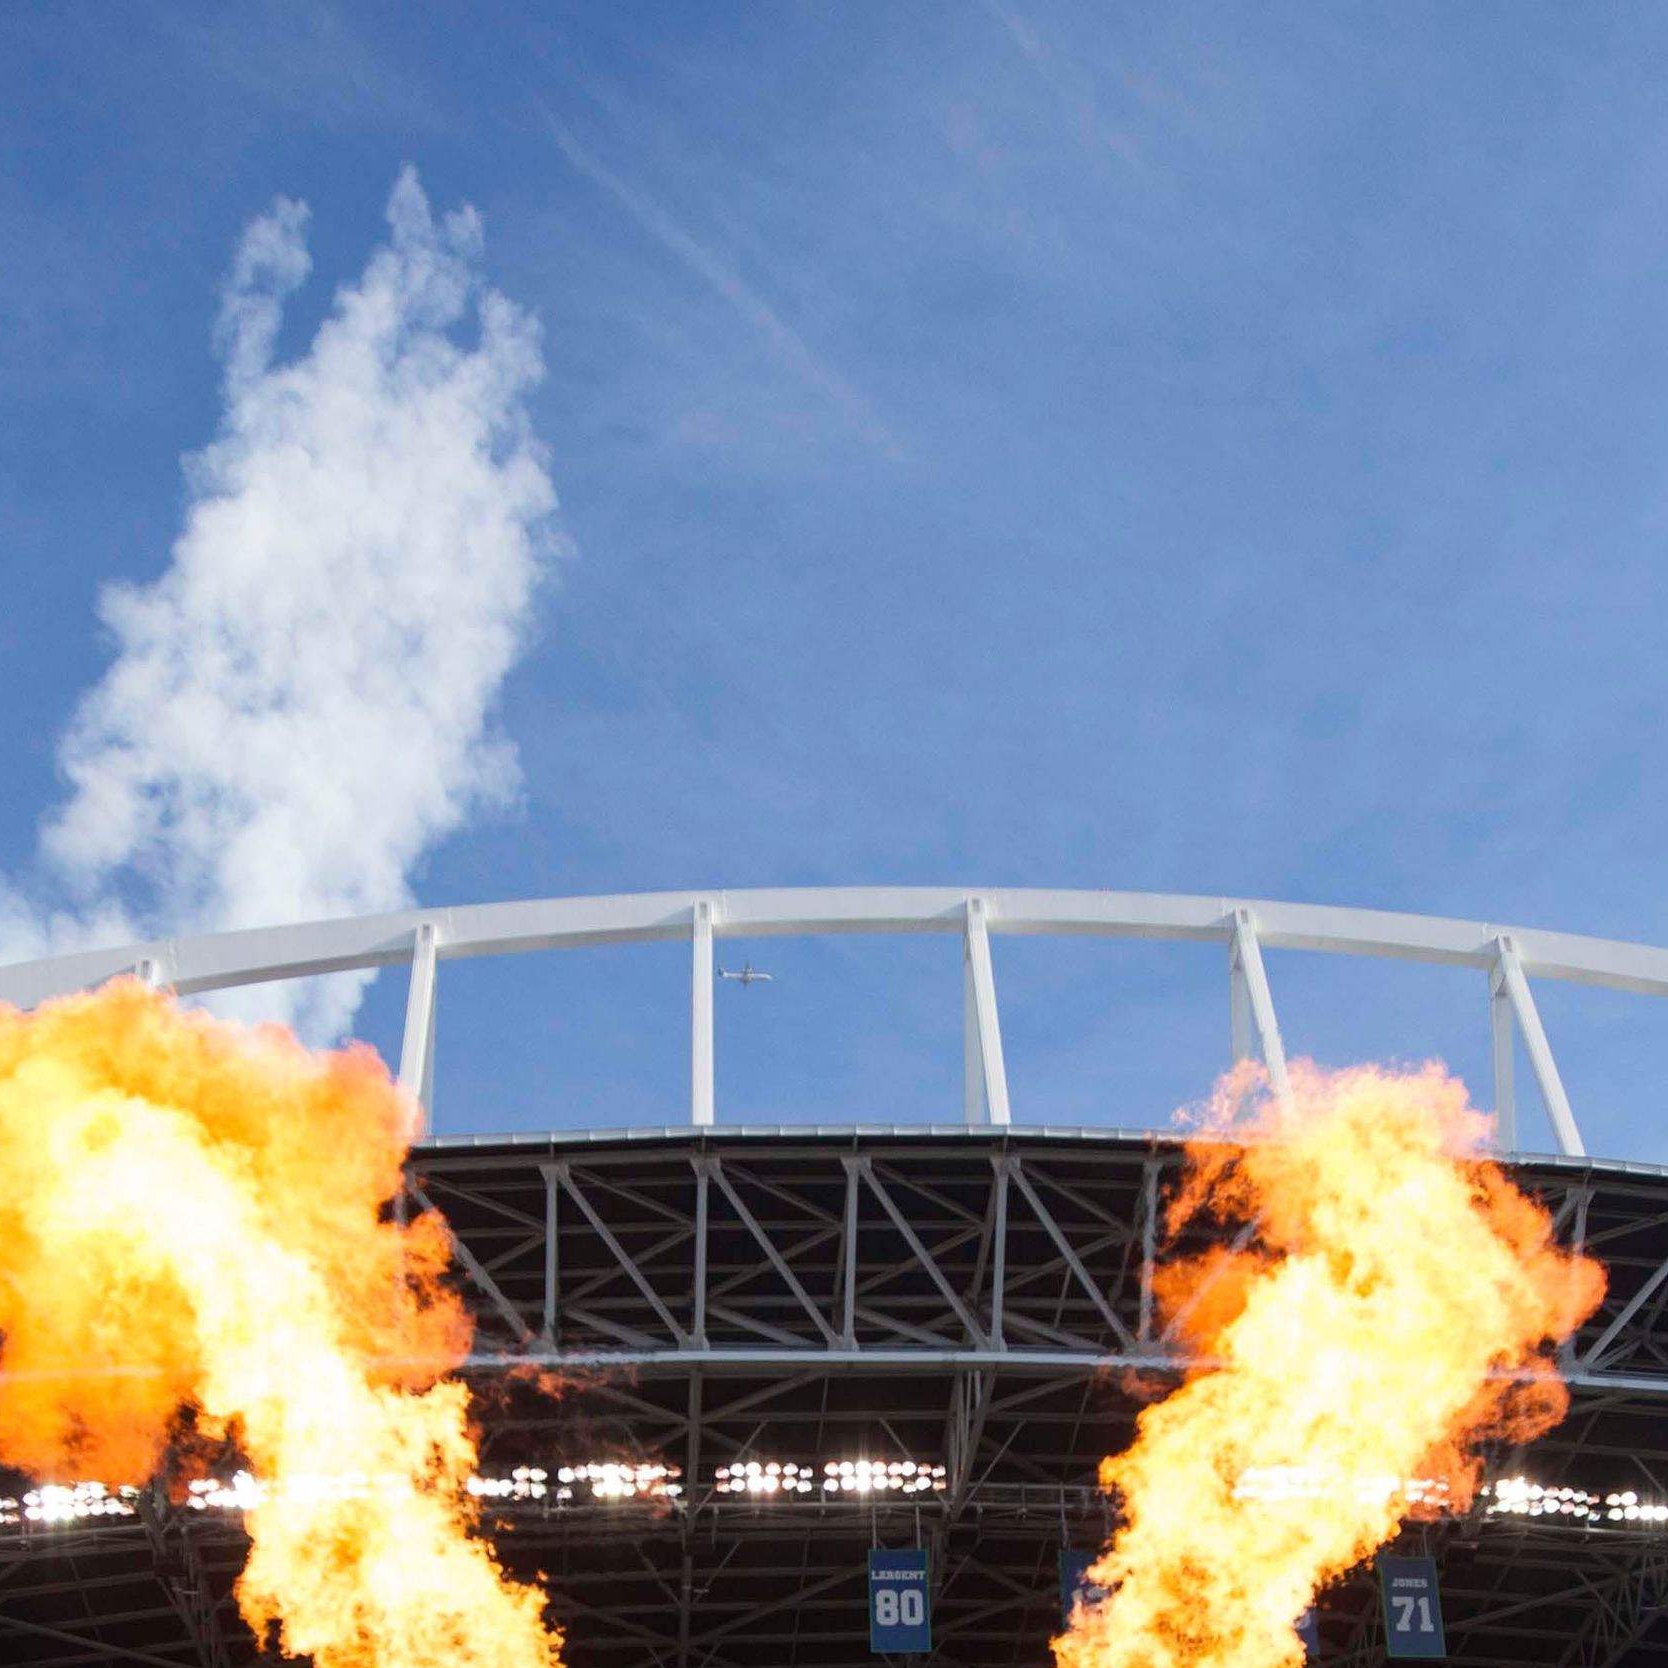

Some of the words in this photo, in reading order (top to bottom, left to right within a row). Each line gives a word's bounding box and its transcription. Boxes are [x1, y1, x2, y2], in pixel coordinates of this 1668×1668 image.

[1392, 1578, 1428, 1588] JONES
[875, 1589, 924, 1626] 80
[1392, 1596, 1435, 1632] 71
